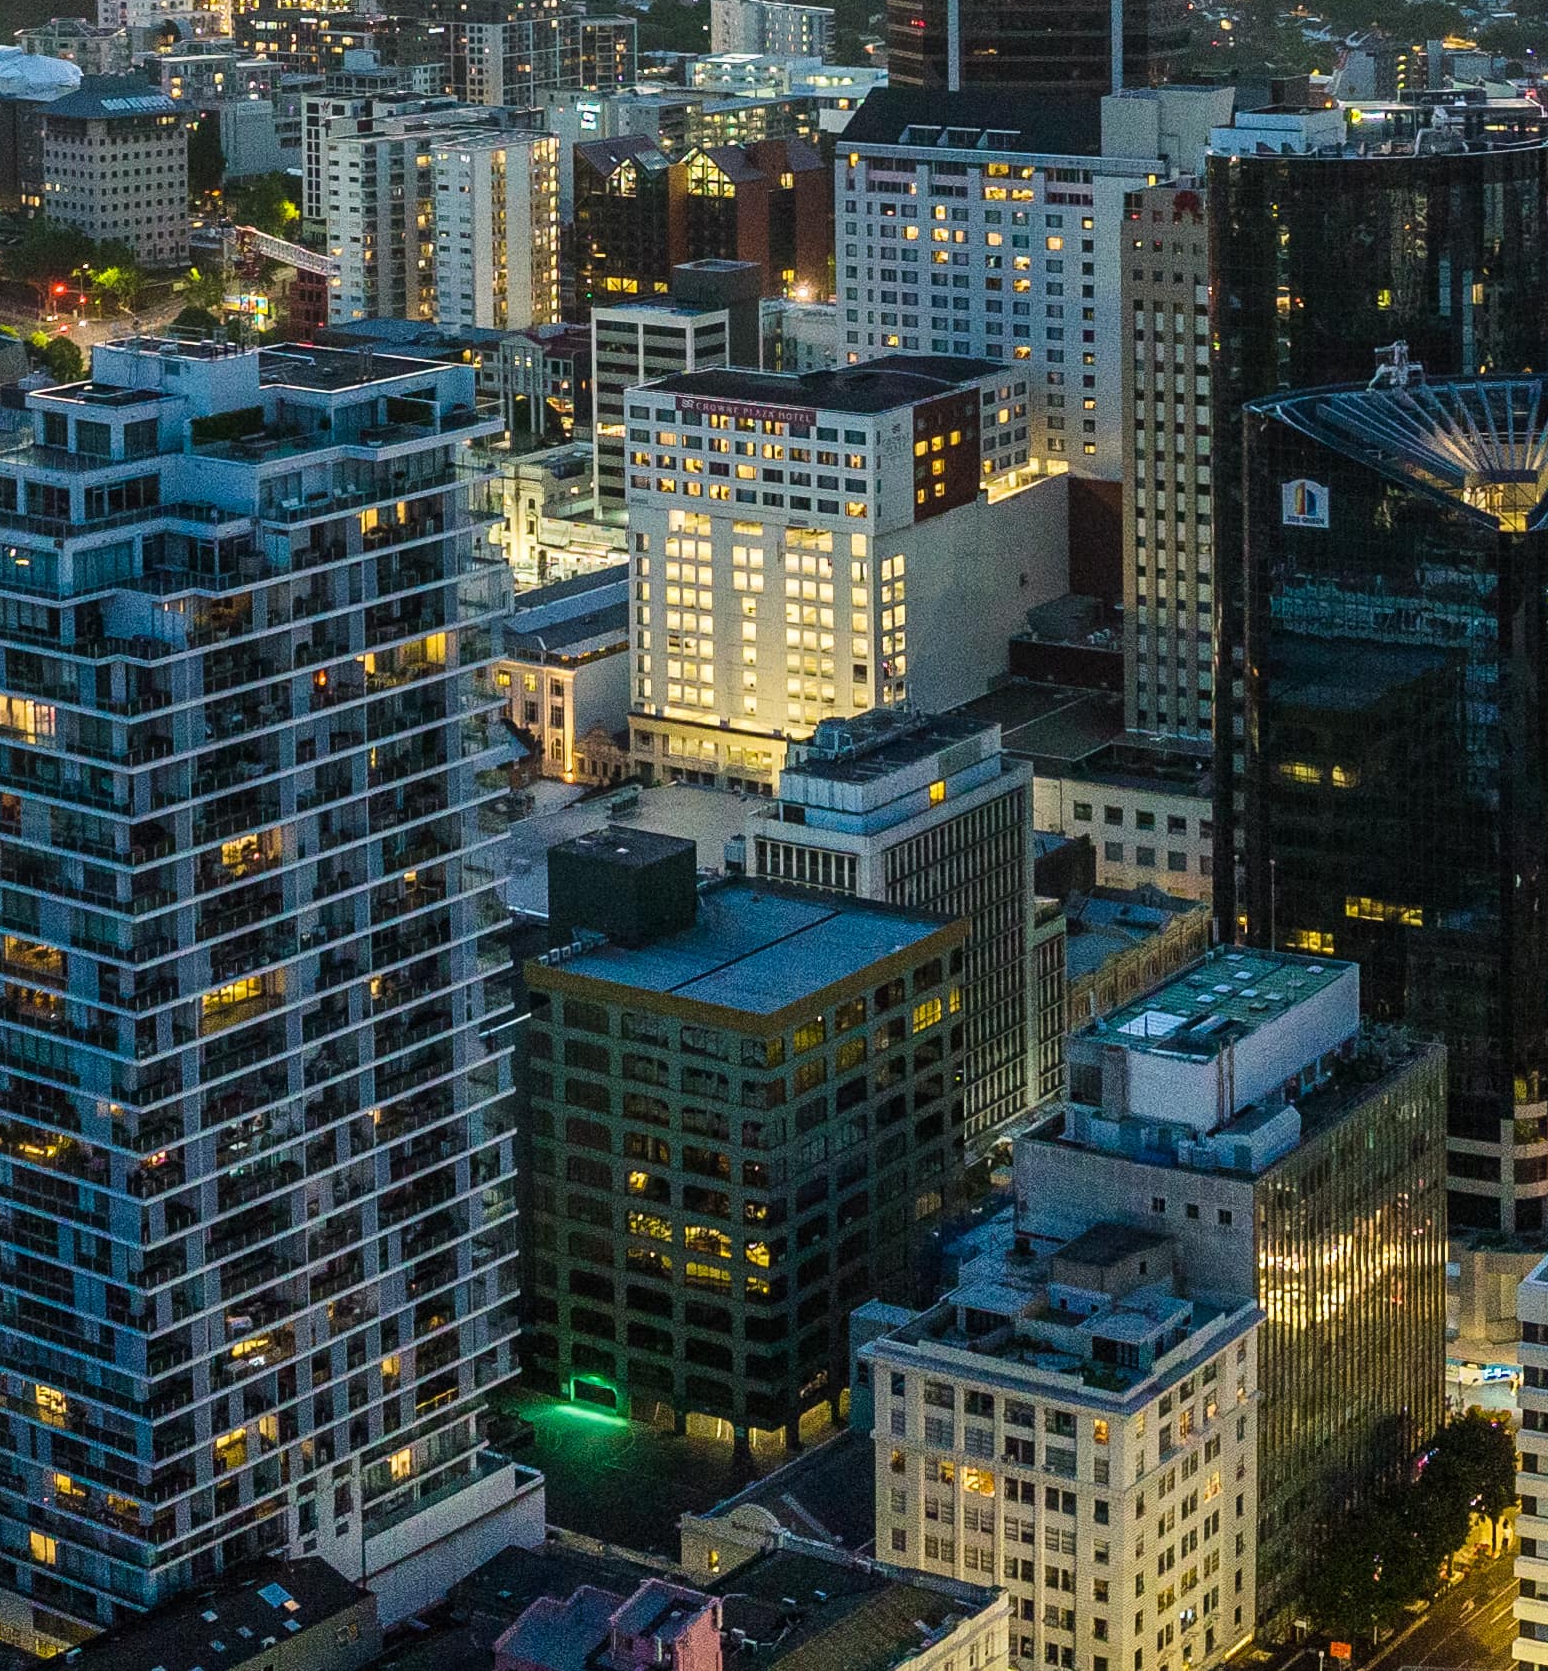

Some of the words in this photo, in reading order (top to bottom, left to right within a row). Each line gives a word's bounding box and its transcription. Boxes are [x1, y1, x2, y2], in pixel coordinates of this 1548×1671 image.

[695, 401, 738, 415] CROWNE
[743, 408, 775, 419] PLAZA
[778, 410, 812, 423] HOTEL
